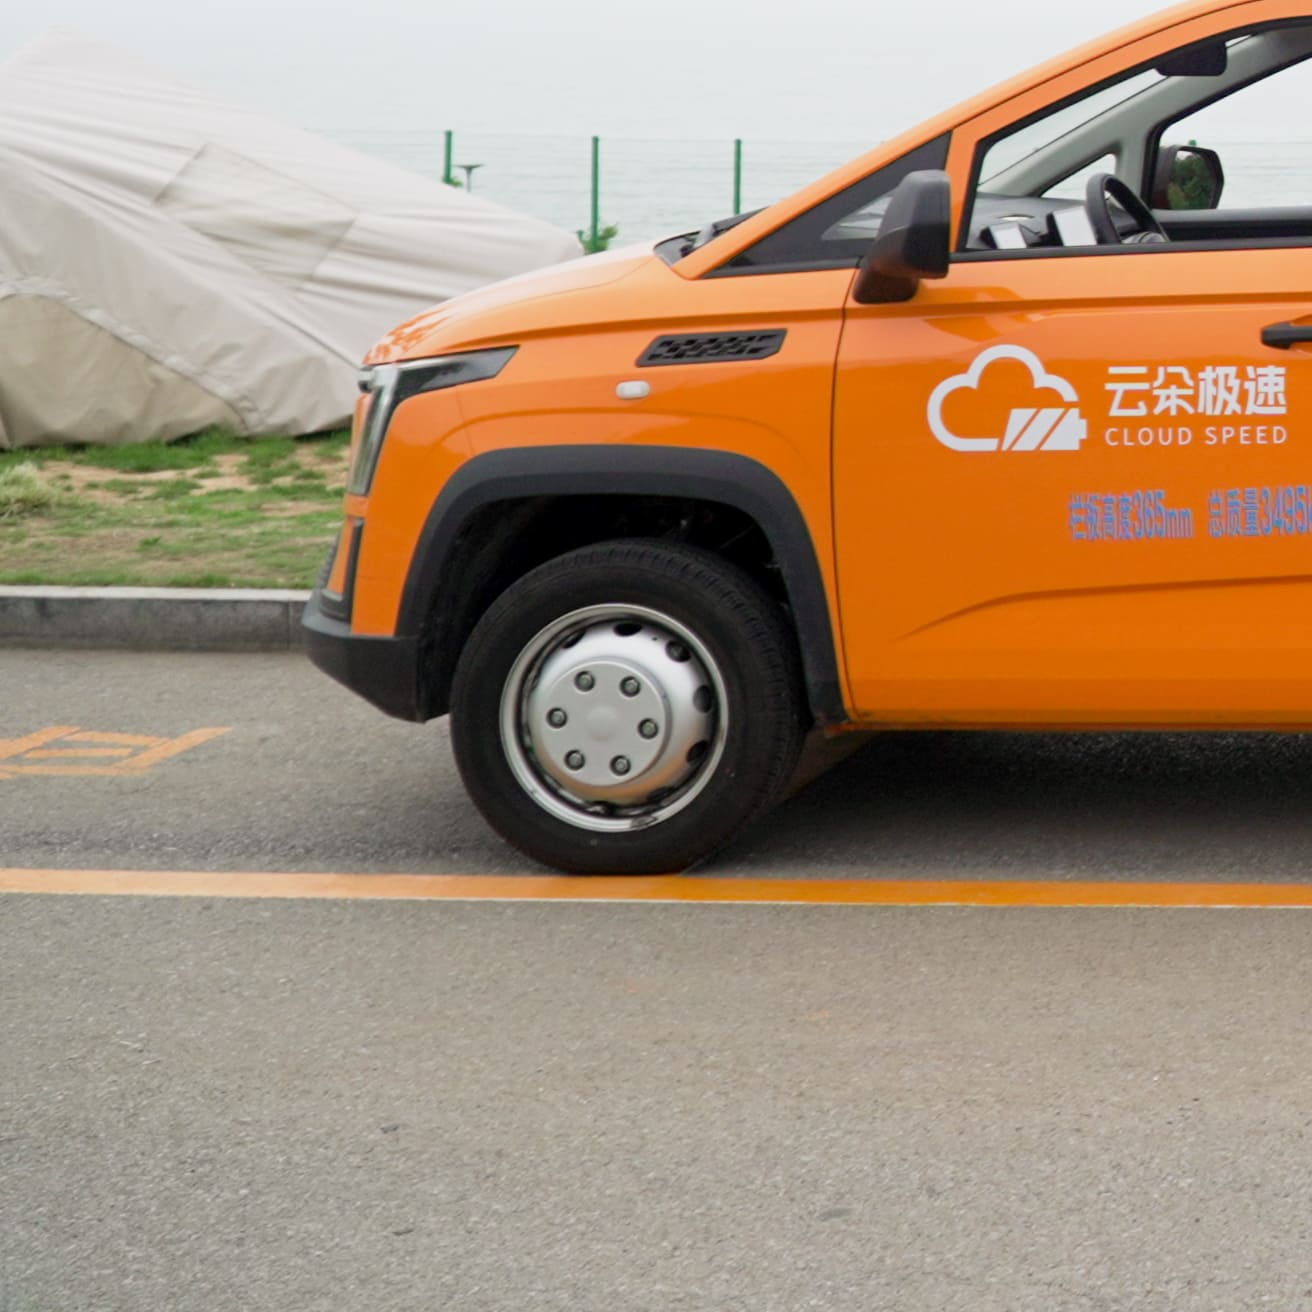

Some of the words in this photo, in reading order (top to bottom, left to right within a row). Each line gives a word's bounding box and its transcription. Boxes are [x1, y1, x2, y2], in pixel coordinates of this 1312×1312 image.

[1104, 365, 1287, 416] 云朵极速
[1104, 427, 1192, 446] CLOUD
[1205, 425, 1287, 444] SPEED
